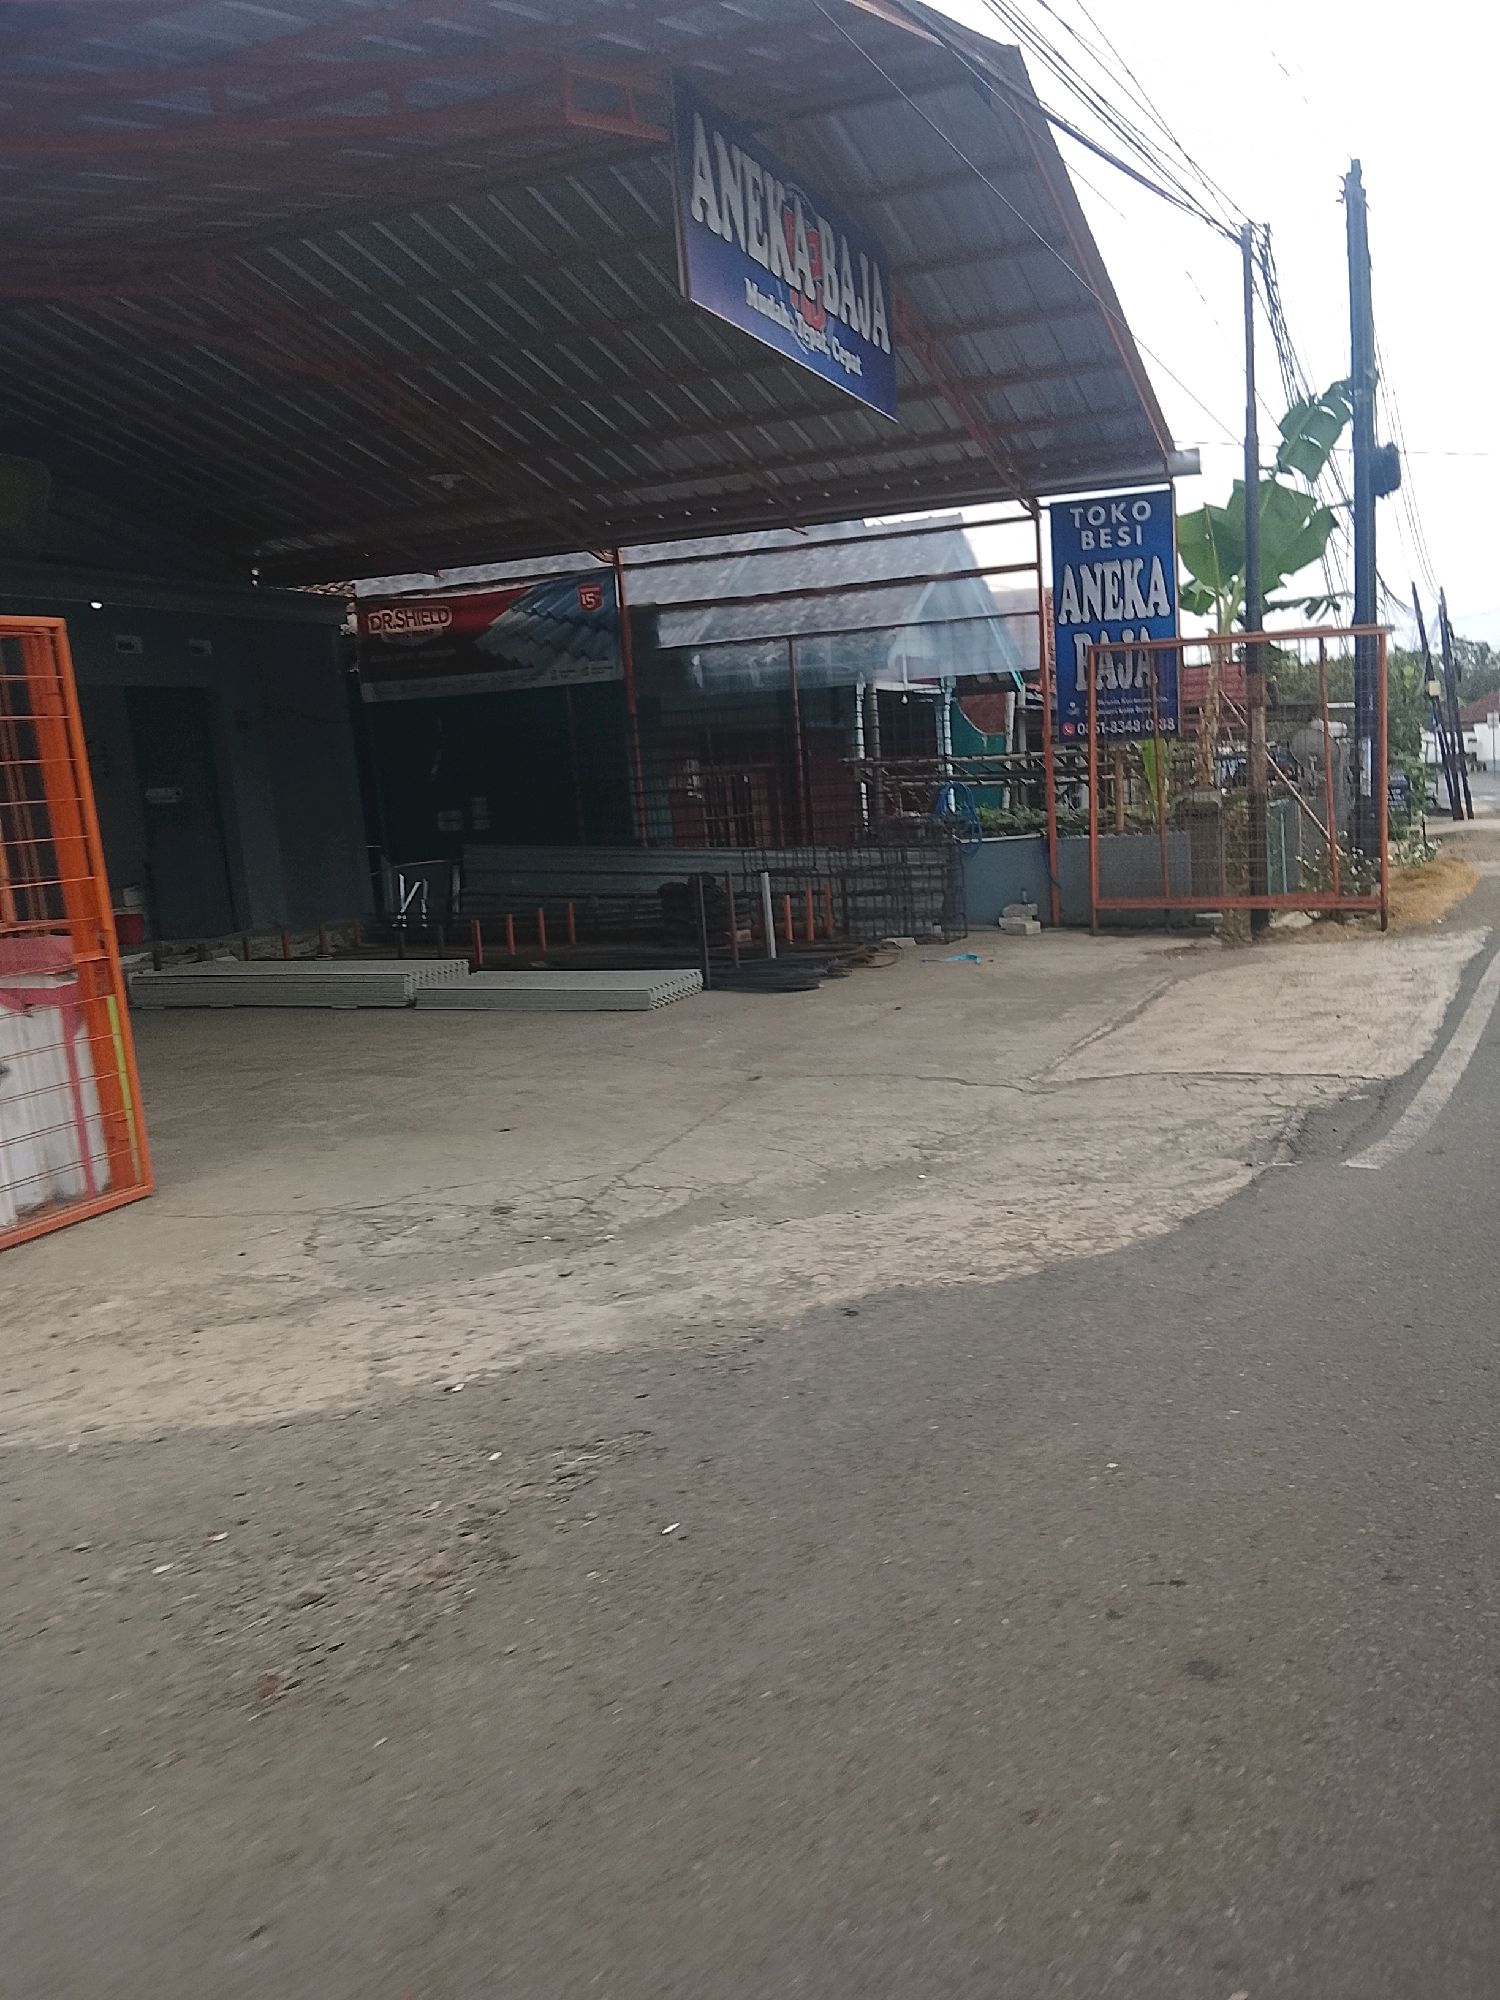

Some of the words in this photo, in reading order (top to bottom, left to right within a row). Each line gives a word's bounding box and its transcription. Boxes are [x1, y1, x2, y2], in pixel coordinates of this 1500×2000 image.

[691, 112, 816, 301] ANEKA
[817, 215, 892, 355] BAJA
[1070, 501, 1152, 528] TOKO
[1081, 525, 1142, 551] BESI
[581, 593, 596, 608] 15
[1058, 556, 1171, 625] ANEKA
